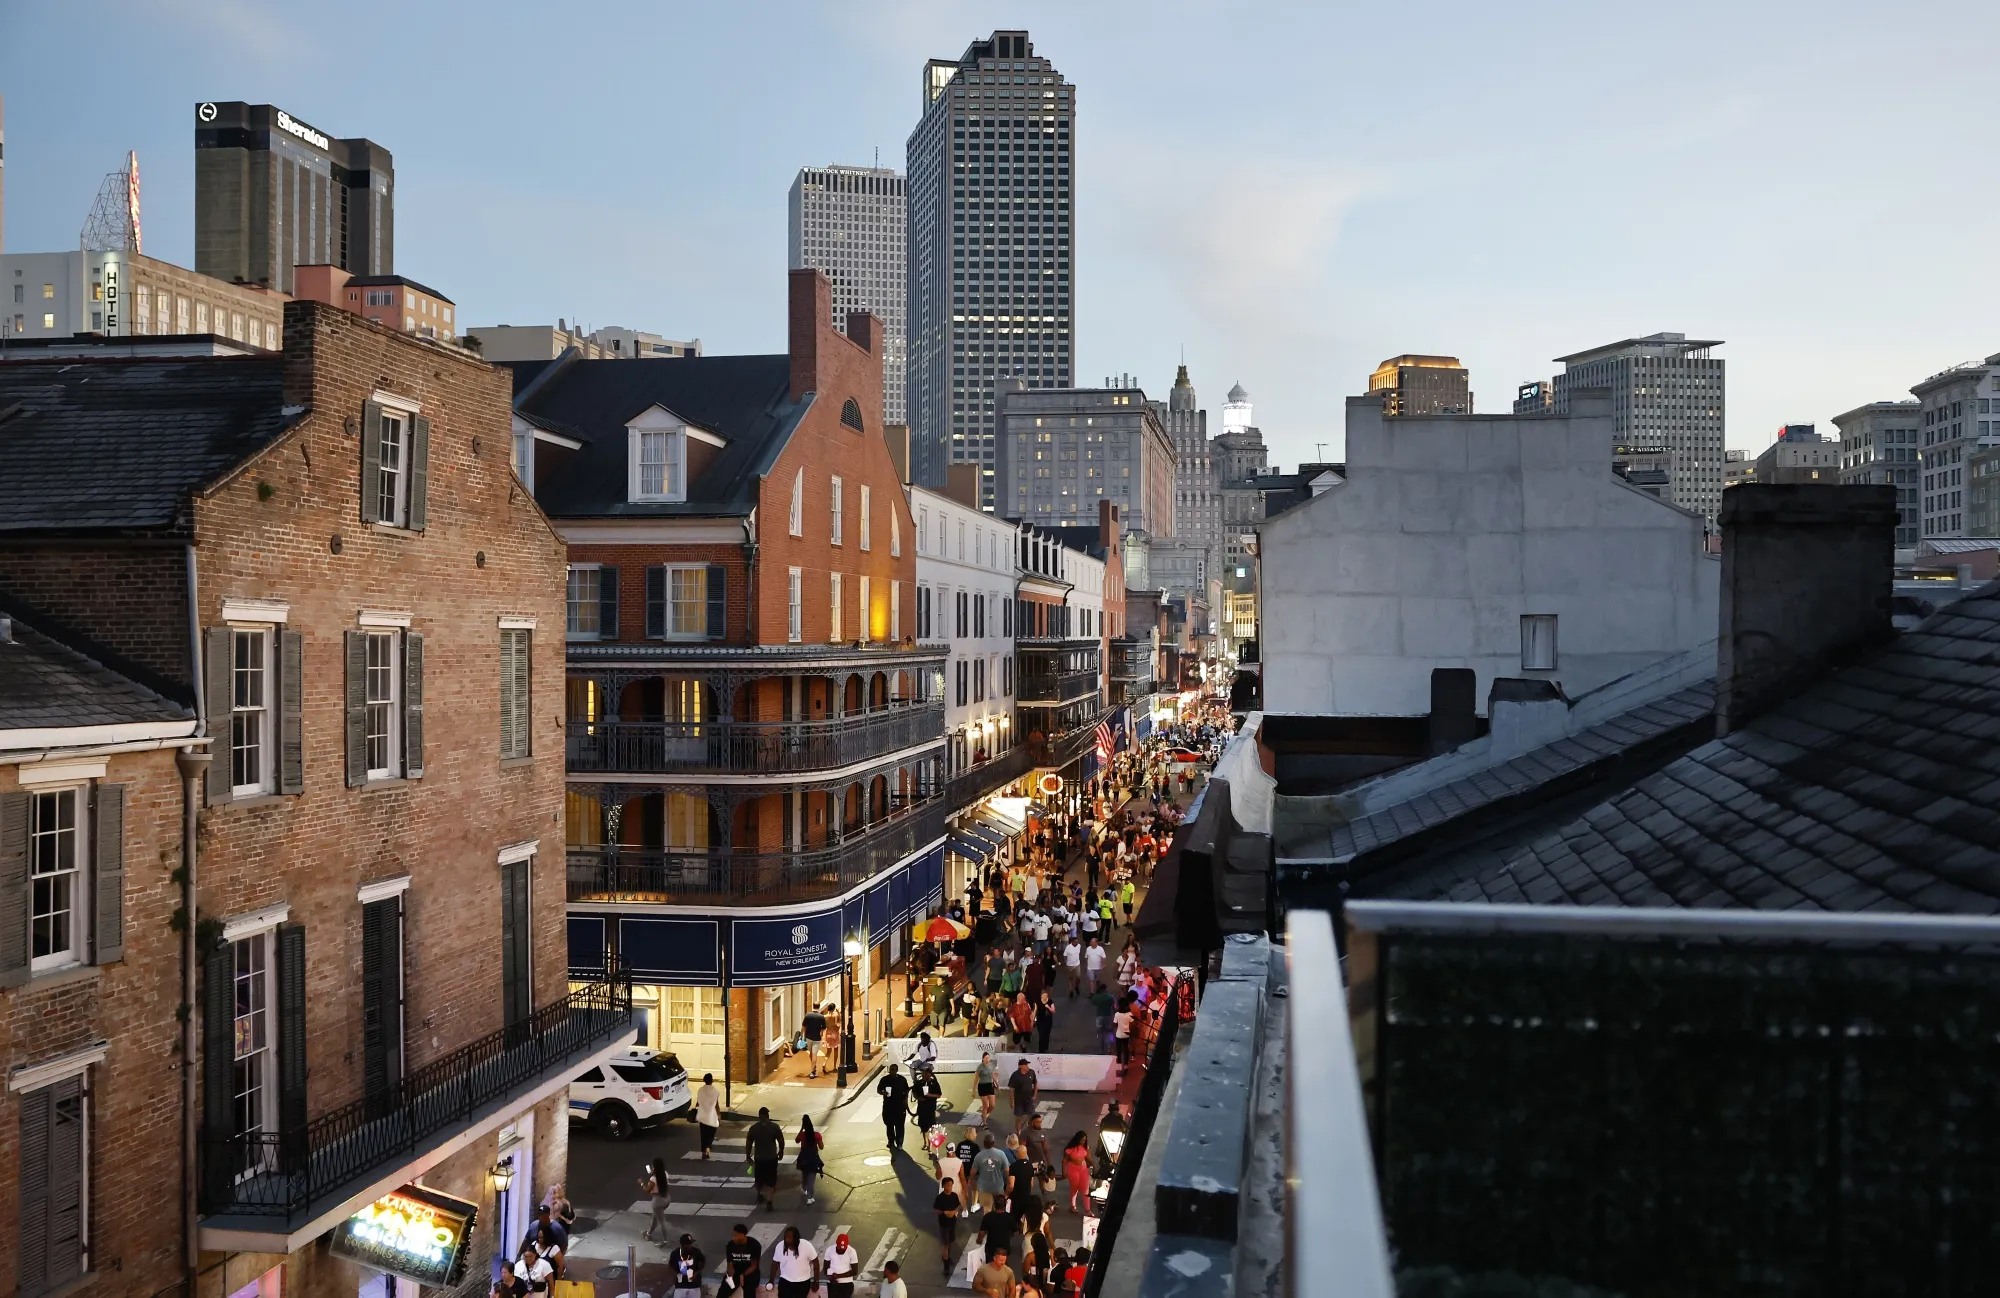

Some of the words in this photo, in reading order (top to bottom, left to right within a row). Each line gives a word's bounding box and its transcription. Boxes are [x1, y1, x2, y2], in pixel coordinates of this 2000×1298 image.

[277, 110, 329, 151] Sheraton
[764, 949, 794, 957] ROYAL
[795, 943, 828, 955] SONESTA
[792, 955, 820, 965] ORLEANS
